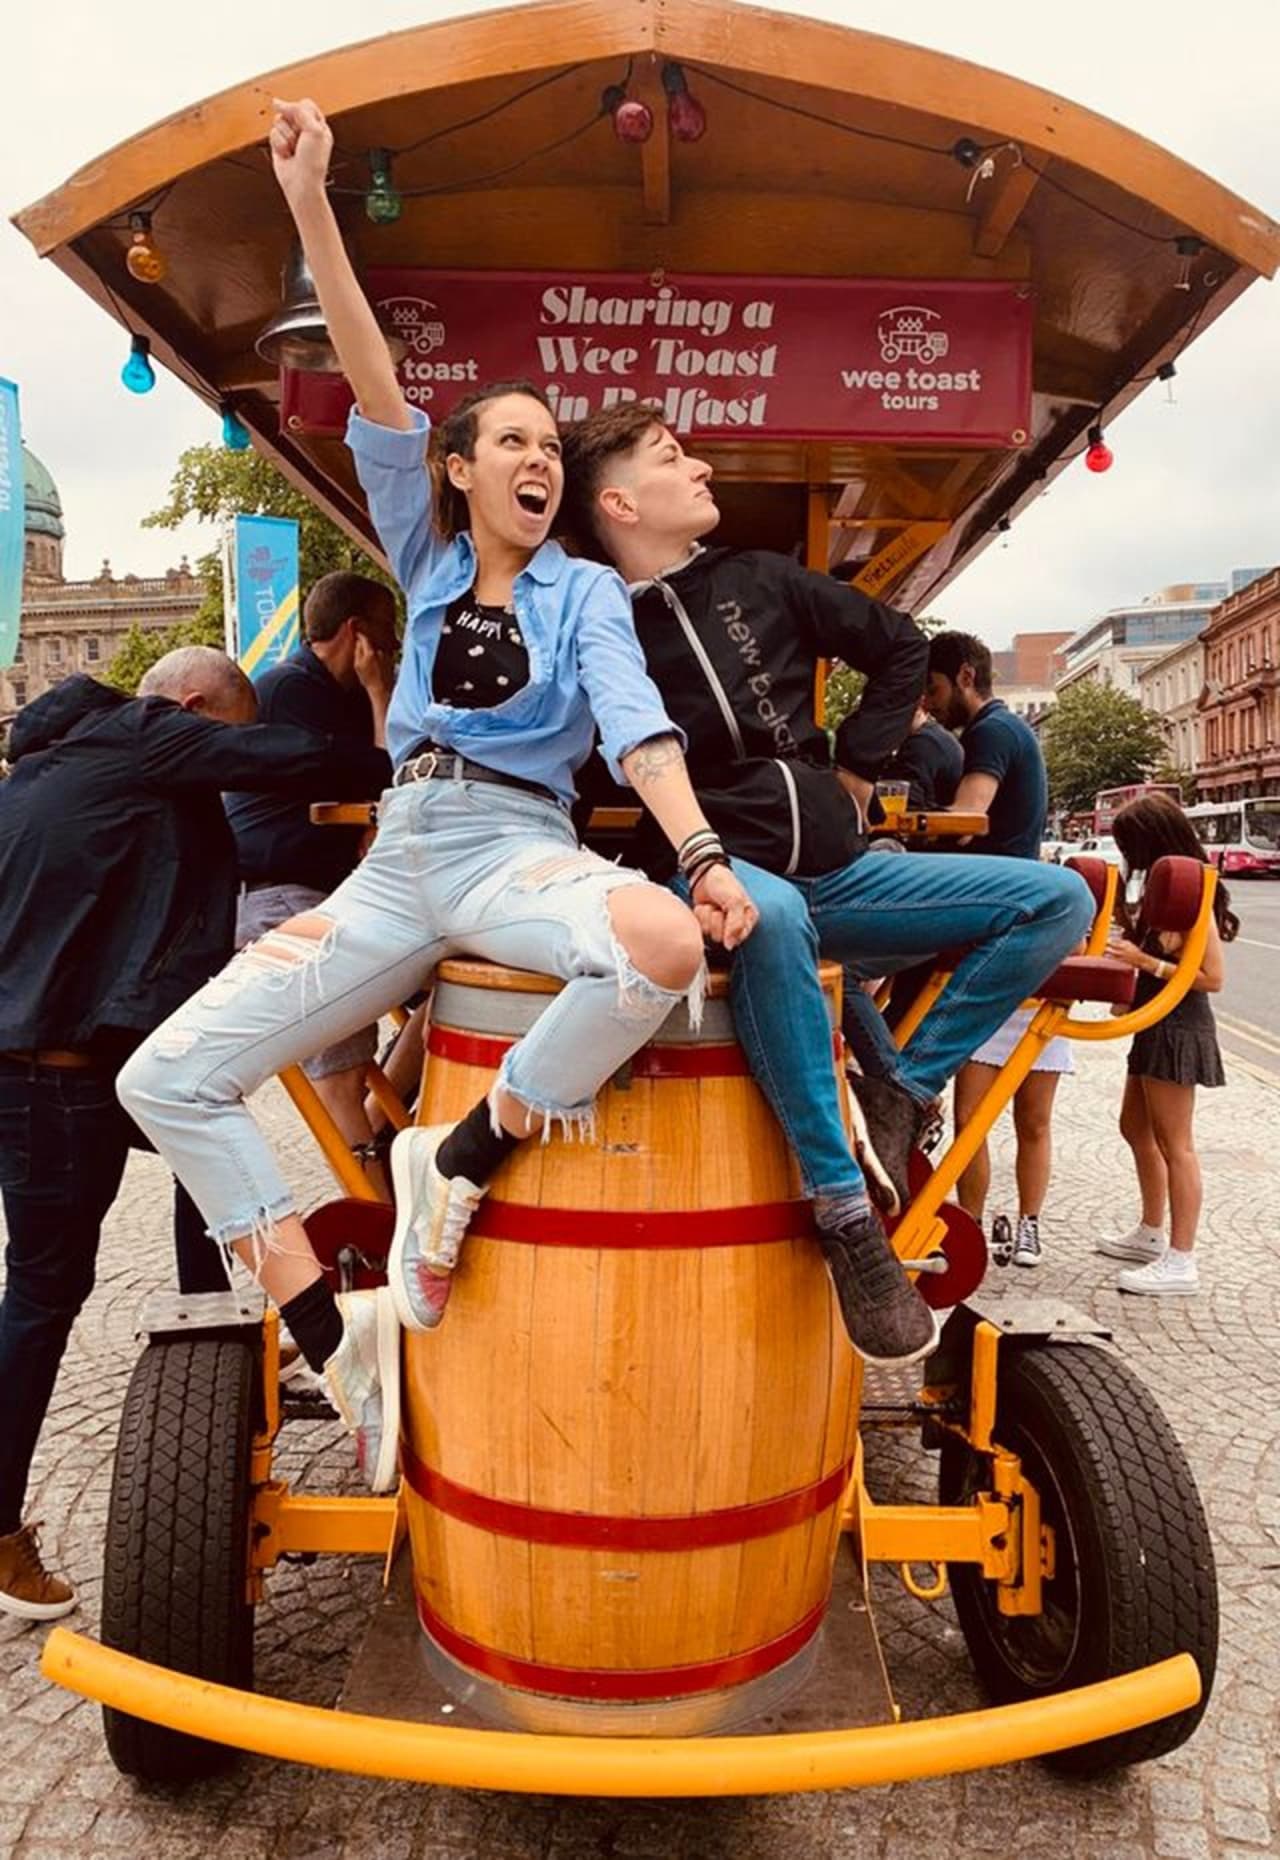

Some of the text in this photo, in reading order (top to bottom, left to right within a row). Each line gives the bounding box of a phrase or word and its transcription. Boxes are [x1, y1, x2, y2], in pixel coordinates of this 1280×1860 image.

[540, 286, 775, 336] Sharing a
[402, 358, 478, 381] toast
[537, 336, 777, 378] Wee Toast
[400, 385, 434, 404] op
[841, 368, 981, 391] wee toast
[545, 383, 590, 422] in
[881, 391, 939, 410] tours
[716, 600, 761, 667] new
